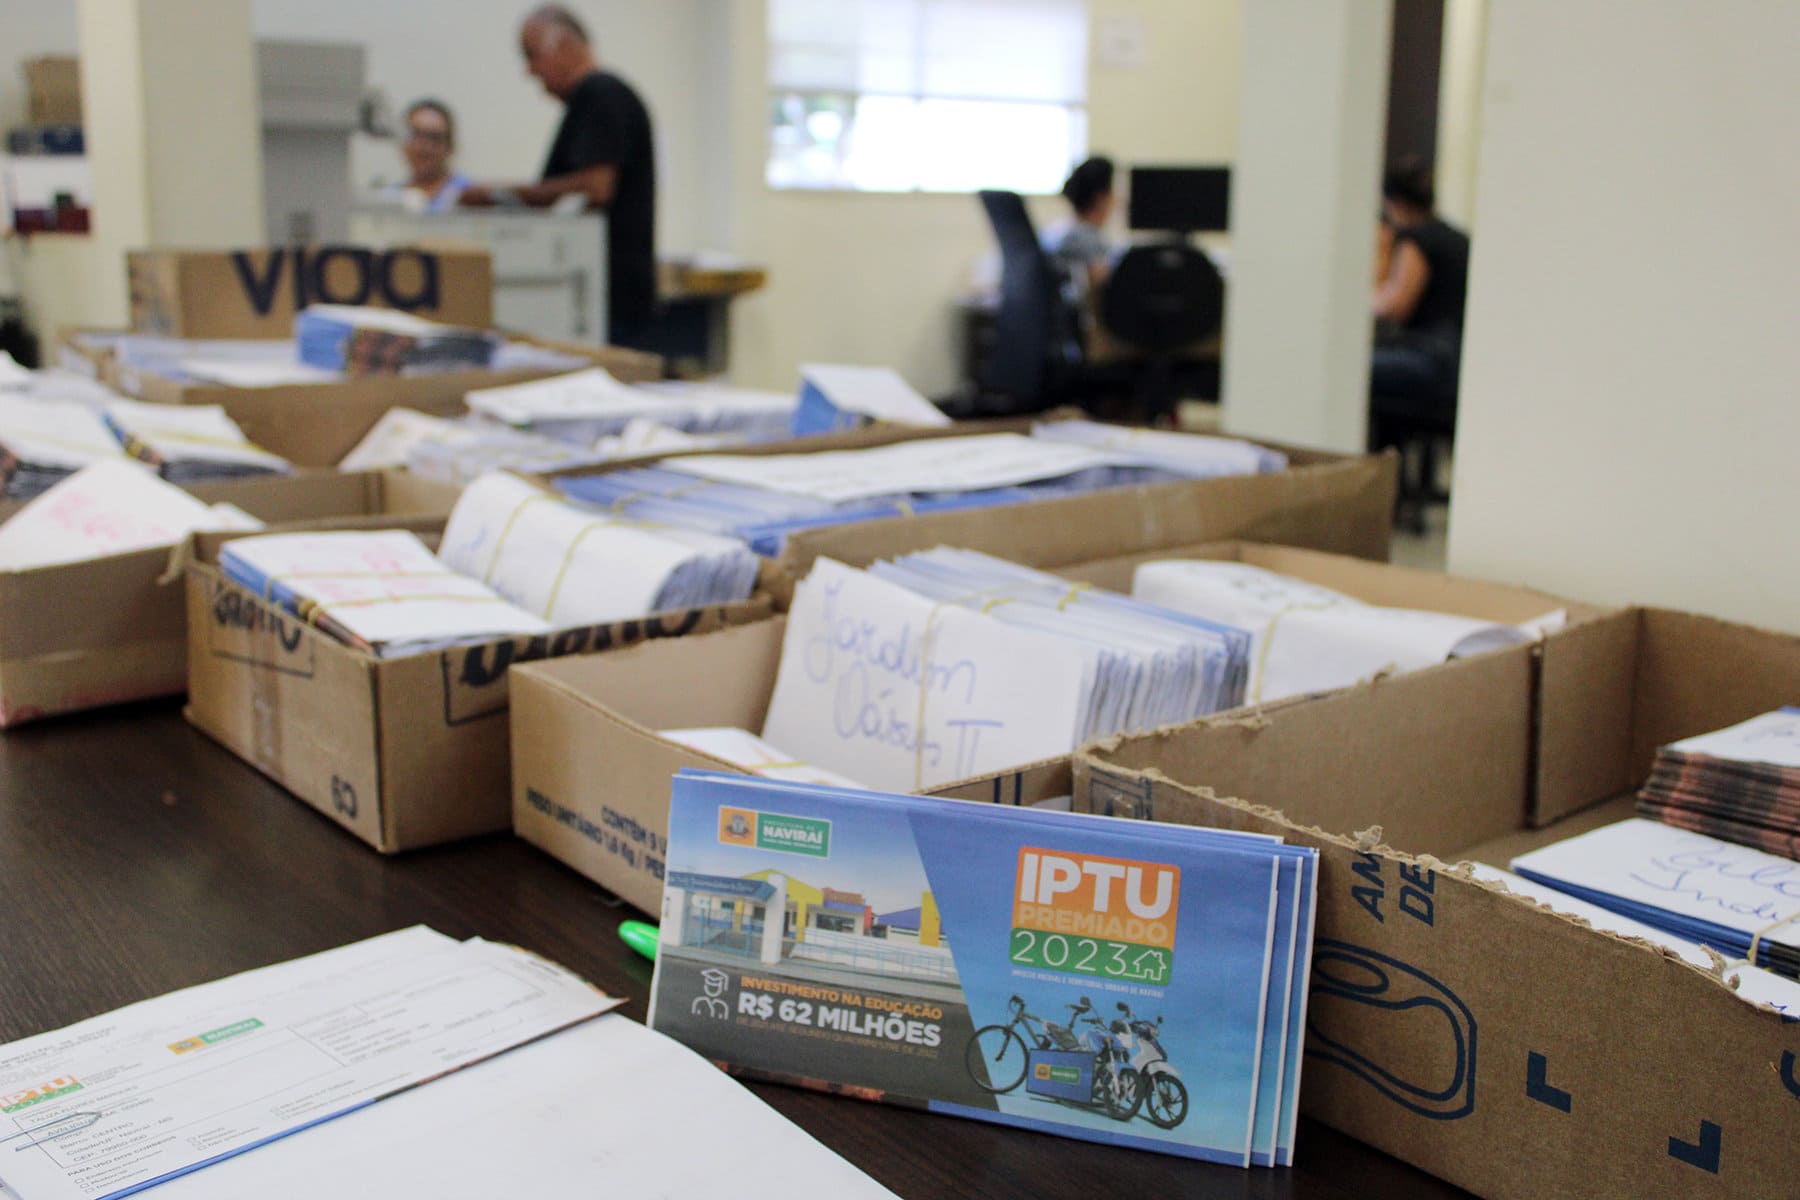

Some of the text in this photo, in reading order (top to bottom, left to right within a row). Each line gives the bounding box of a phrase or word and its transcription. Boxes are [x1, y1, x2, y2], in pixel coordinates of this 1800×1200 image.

[763, 825, 823, 845] NAVIRAÍ
[1020, 853, 1173, 920] IPTU
[1019, 905, 1168, 943] PREMIADO
[1013, 931, 1128, 976] 2023
[738, 992, 773, 1021] R$
[779, 999, 812, 1026] 62
[818, 1005, 942, 1047] MILHÕES
[740, 975, 943, 1020] INVESTIMENTO NA EDUCAÇÃO
